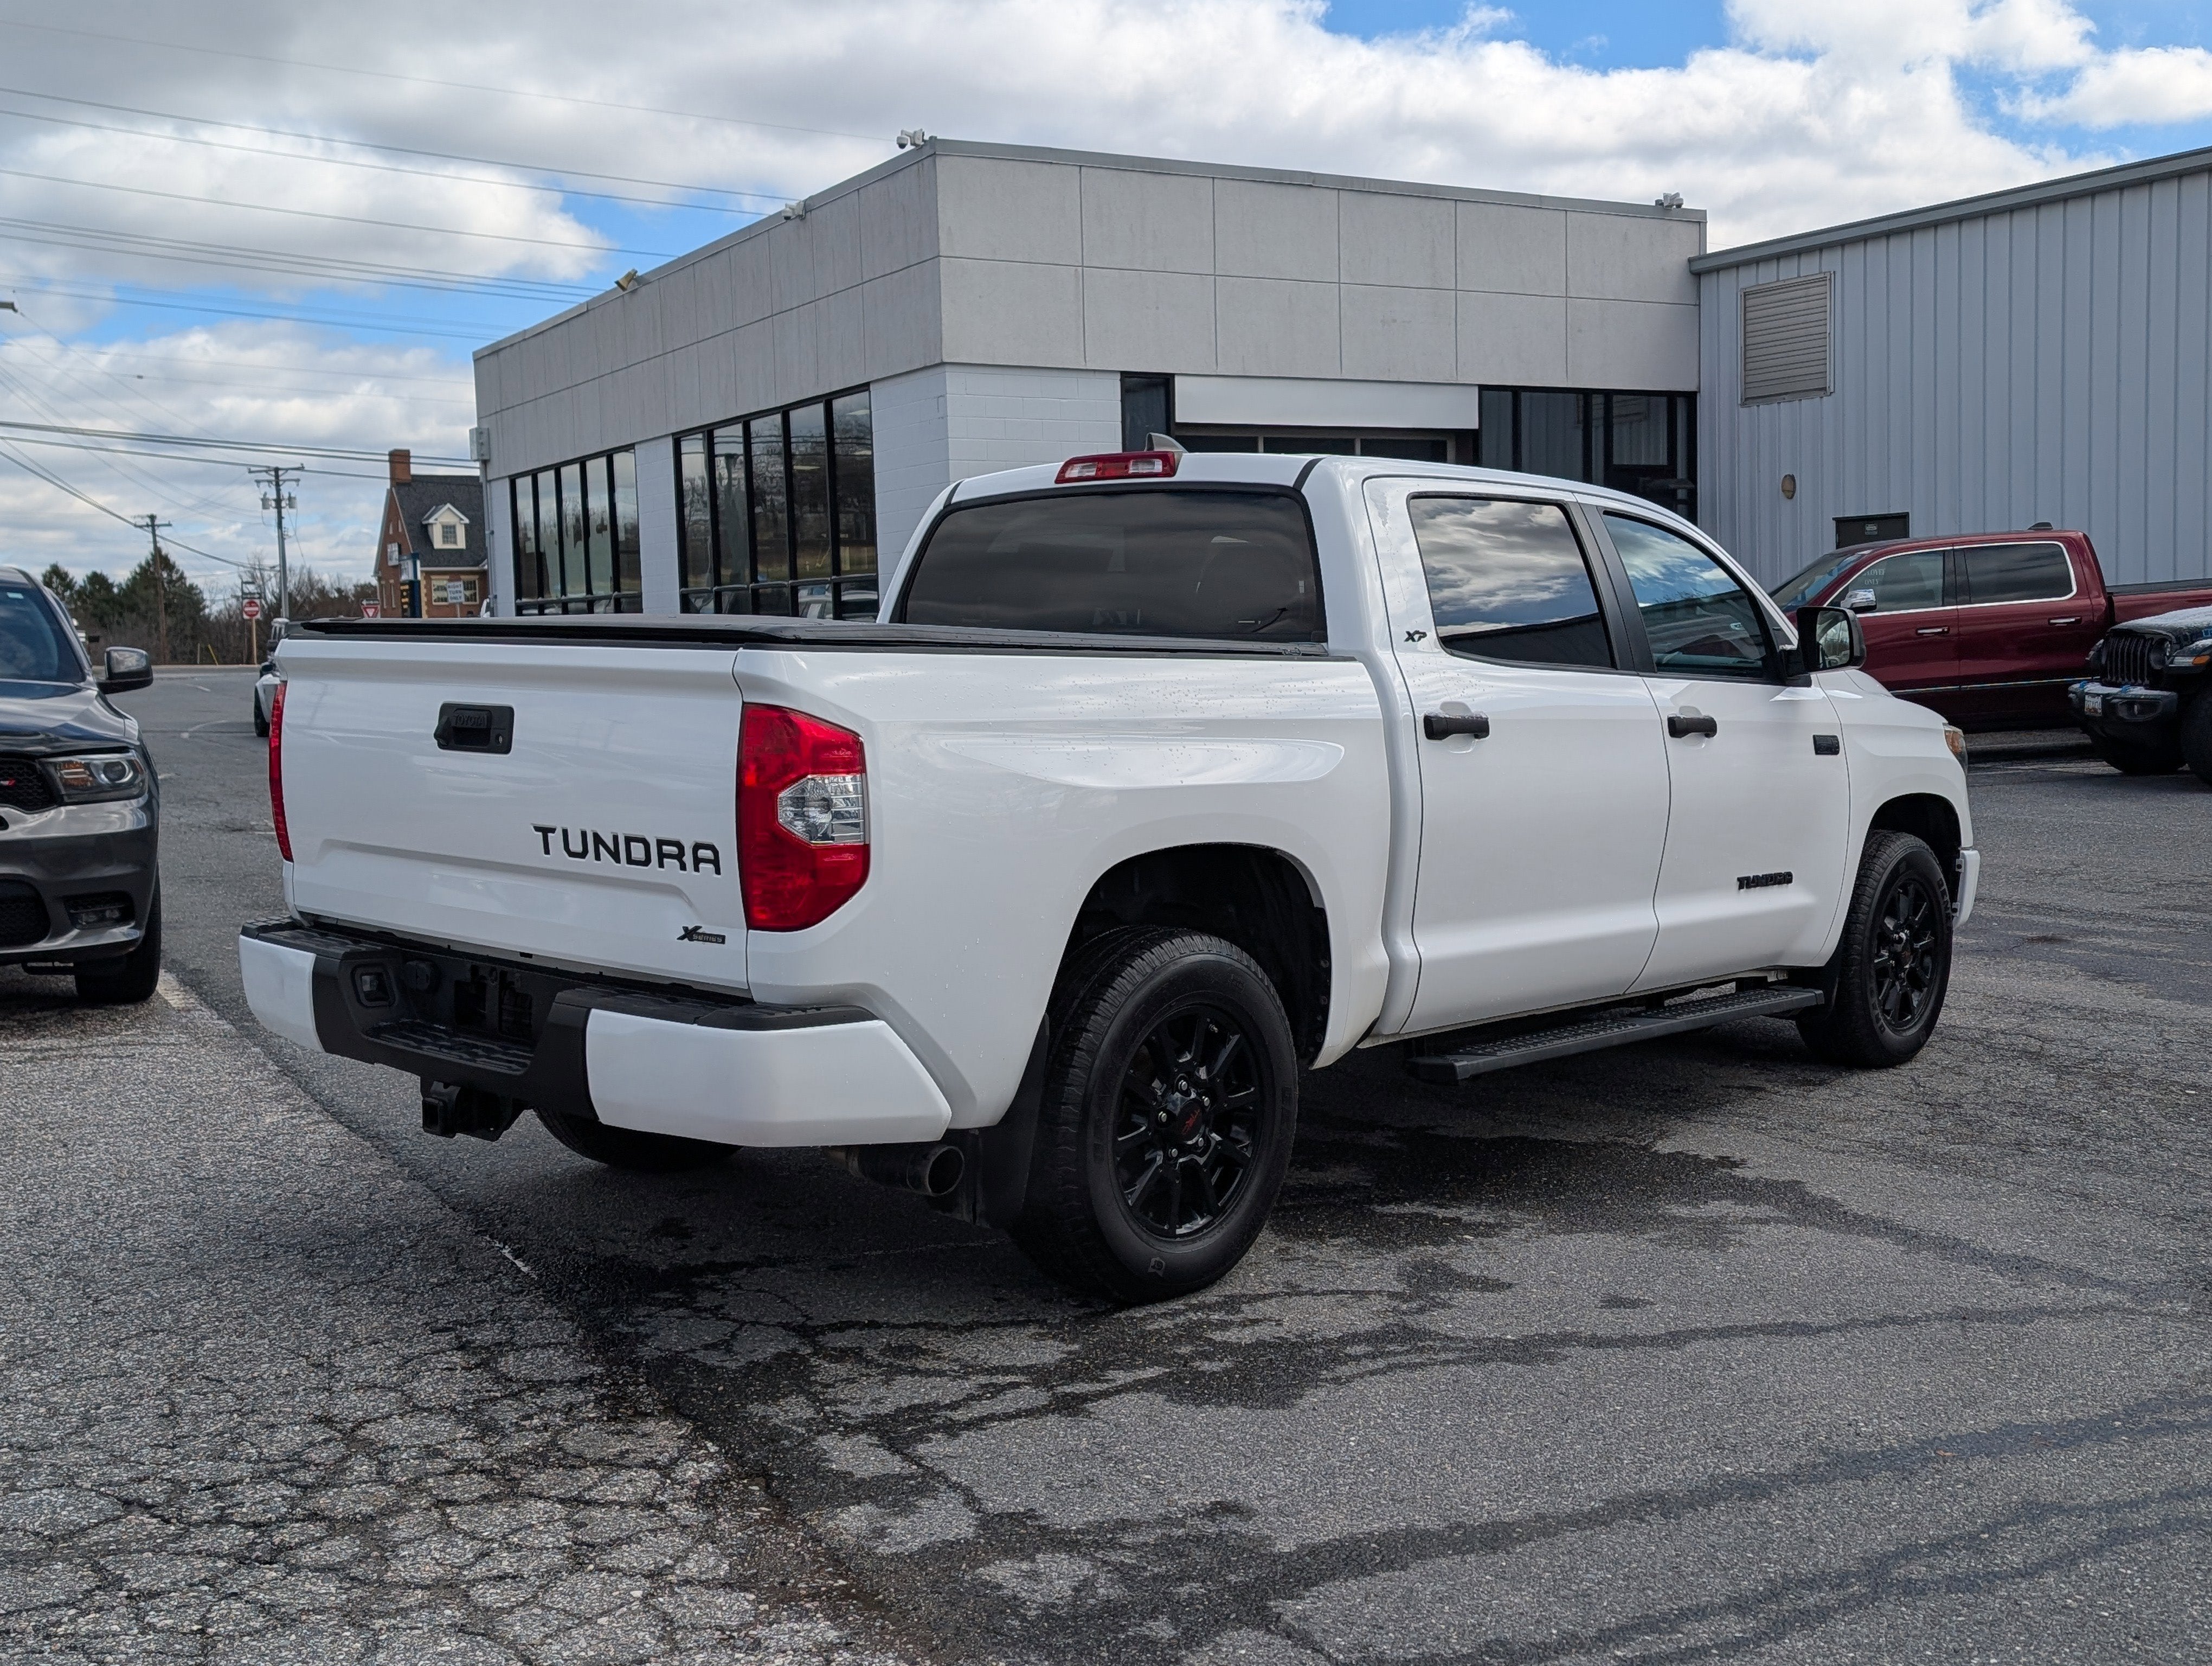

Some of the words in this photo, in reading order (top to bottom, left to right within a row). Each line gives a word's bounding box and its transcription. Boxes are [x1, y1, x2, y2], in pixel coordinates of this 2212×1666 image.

[1404, 630, 1427, 643] XP
[454, 714, 487, 727] TOYOTA
[532, 824, 721, 876] TUNDRA
[1737, 872, 1793, 890] TUNDRA
